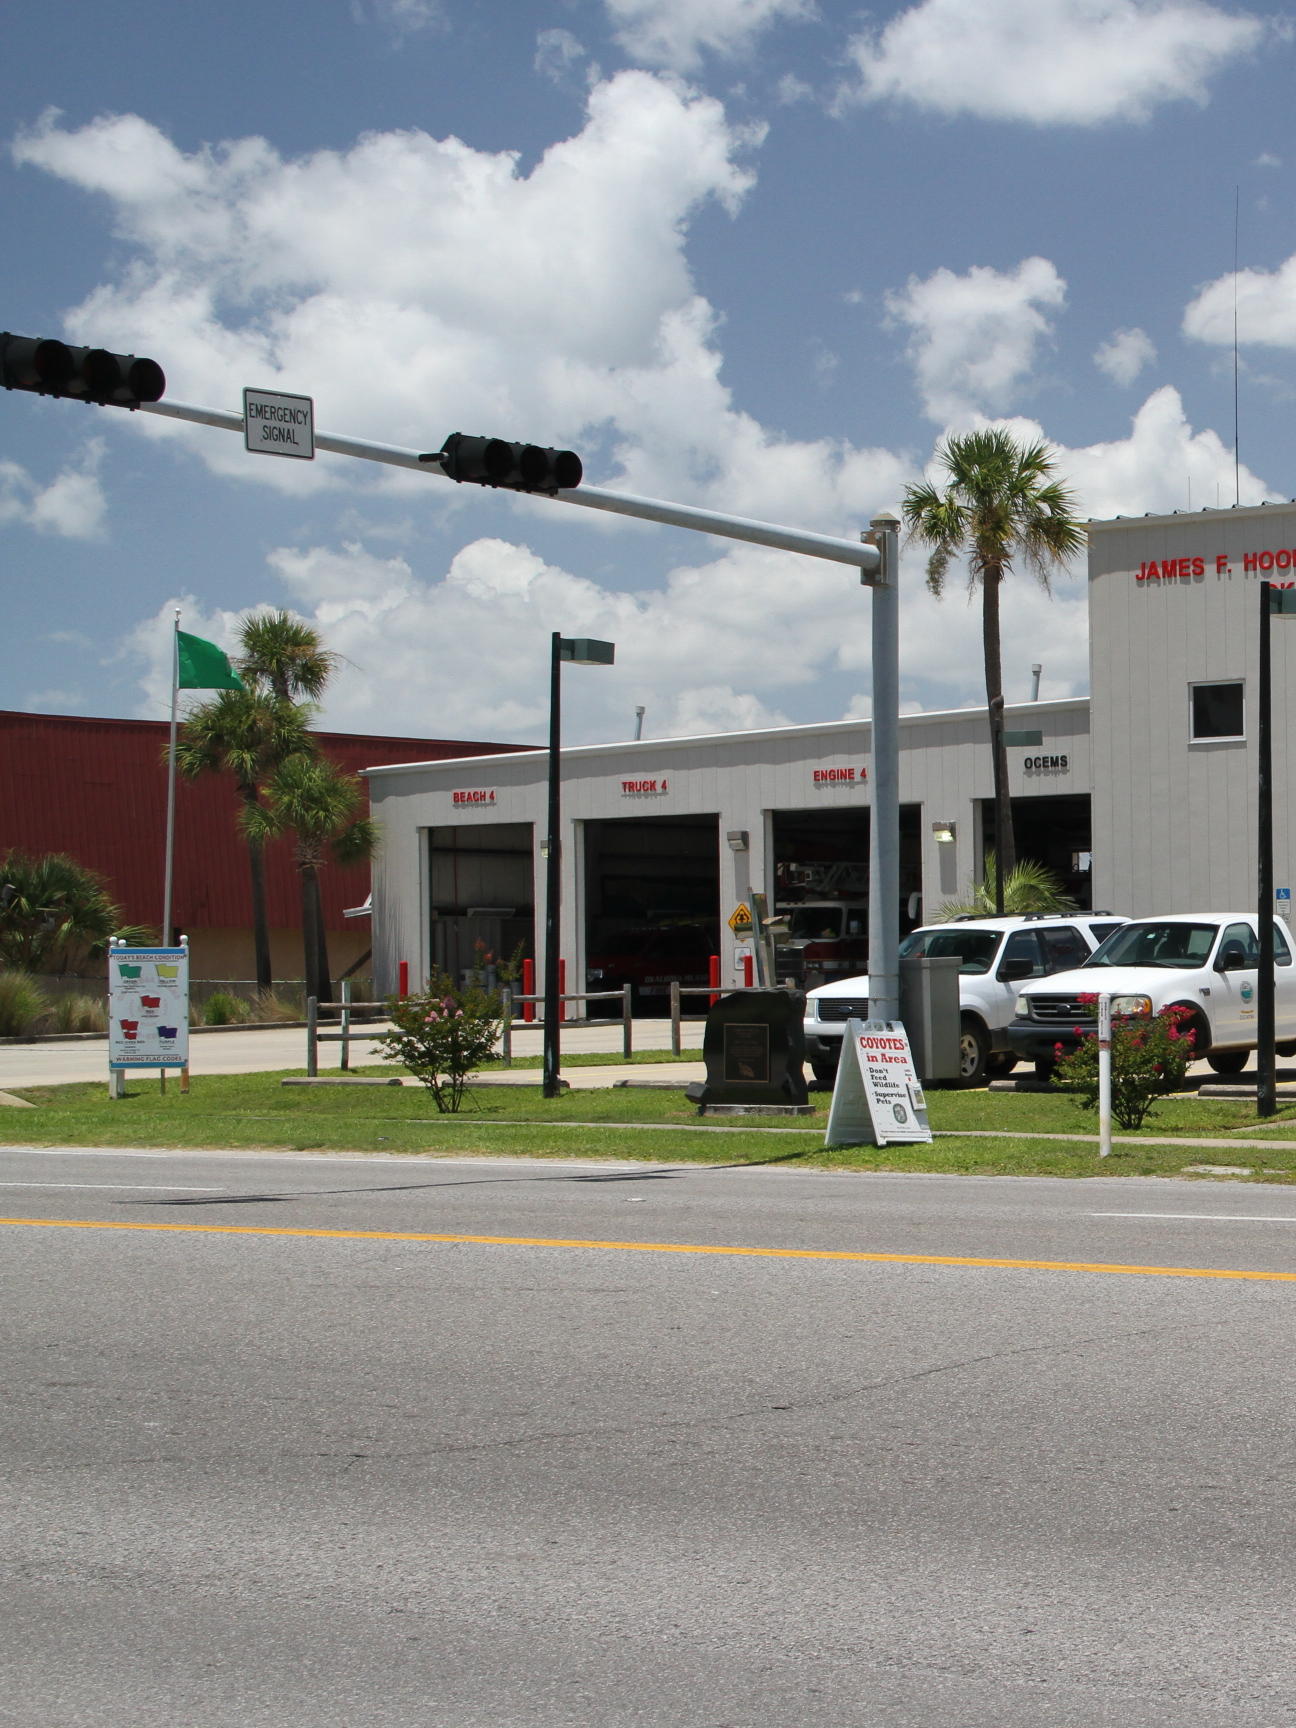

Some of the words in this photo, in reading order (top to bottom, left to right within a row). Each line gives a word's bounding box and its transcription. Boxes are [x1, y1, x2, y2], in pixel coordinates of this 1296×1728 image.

[248, 402, 309, 425] EMERGENCY
[262, 424, 299, 446] SIGNAL
[1135, 556, 1205, 581] JAMES
[1215, 554, 1232, 574] F.
[1024, 754, 1068, 770] OCEMS
[813, 768, 855, 782] ENGINE
[860, 767, 867, 779] 4
[622, 780, 657, 793] TRUCK
[661, 779, 668, 790] 4
[453, 791, 487, 803] BEACH
[489, 790, 495, 800] 4
[860, 1036, 905, 1050] COYOTES
[866, 1052, 879, 1063] in
[880, 1053, 908, 1064] Area
